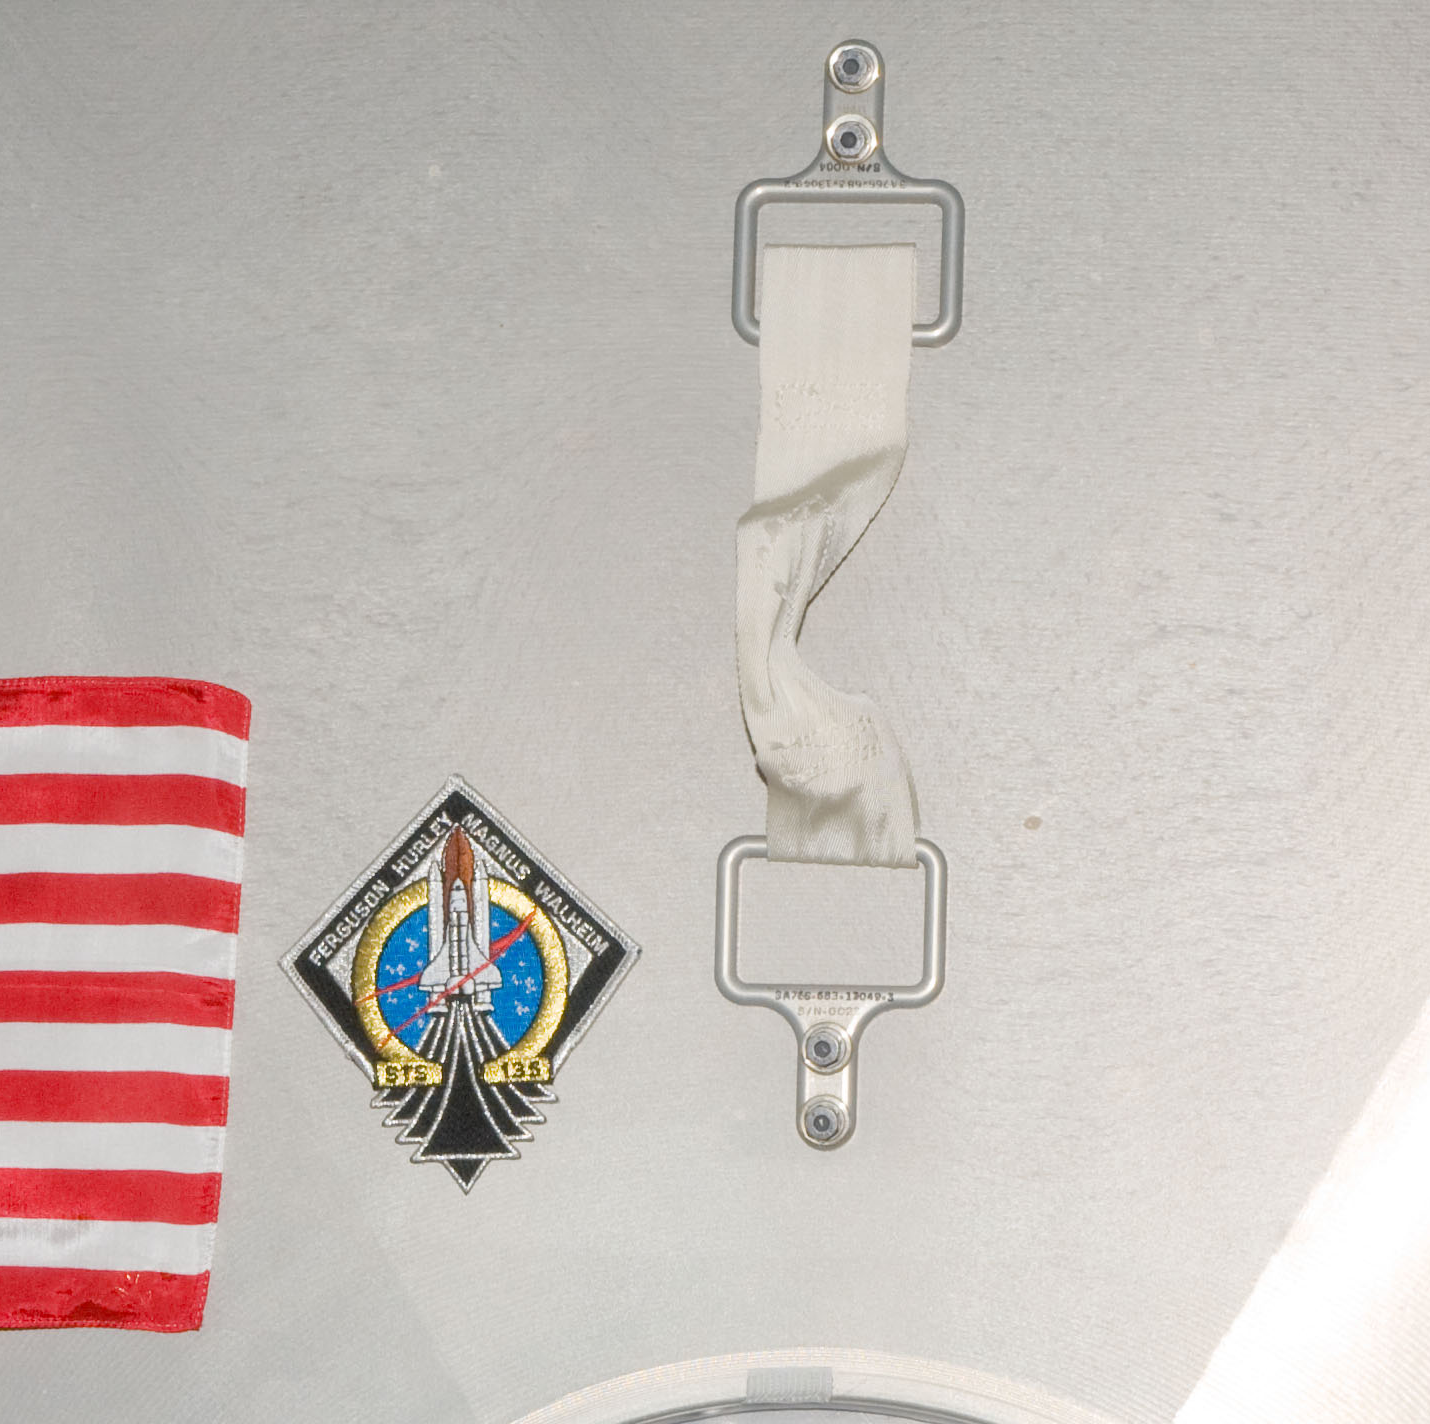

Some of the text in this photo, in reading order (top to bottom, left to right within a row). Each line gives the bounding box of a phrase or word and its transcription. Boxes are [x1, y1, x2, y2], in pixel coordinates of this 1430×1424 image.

[309, 811, 609, 966] FERGUSON HURLEY MAGNUS WALHEIM
[385, 1060, 542, 1085] STS 135
